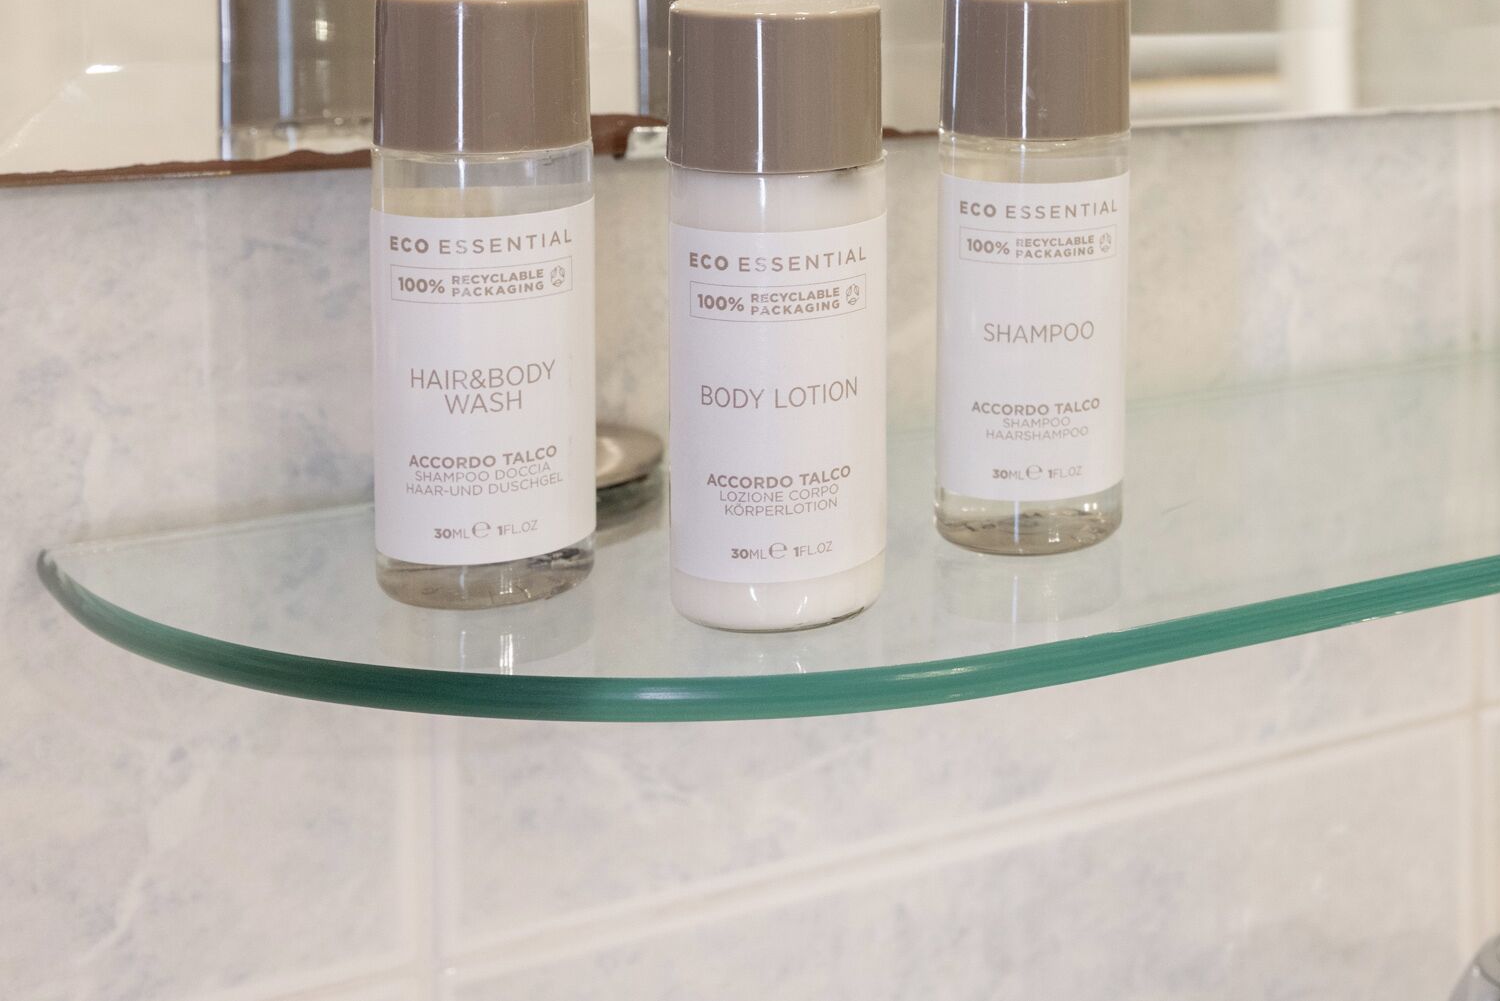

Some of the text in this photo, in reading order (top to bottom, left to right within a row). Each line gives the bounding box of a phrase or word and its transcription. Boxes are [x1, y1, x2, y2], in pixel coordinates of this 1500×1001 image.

[960, 200, 1118, 220] ECO ESSENTIAL
[390, 229, 572, 254] ECO ESSENTIAL
[967, 235, 1094, 255] 100% RECYCLABLE
[689, 247, 866, 272] ECO ESSENTIAL
[1016, 246, 1094, 259] PACKAGING
[398, 269, 544, 294] 100% RECYCLABLE
[452, 281, 544, 297] PACKAGING
[697, 287, 840, 312] 100% RECYCLABLE
[751, 300, 840, 316] PACKAGING
[984, 320, 1094, 344] SHAMPOO
[410, 360, 556, 390] HAIR&BODY
[444, 390, 522, 414] WASH
[701, 376, 858, 409] BODY LOTION
[971, 398, 1100, 416] ACCORDO TALCO
[1003, 416, 1071, 428] SHAMPOO
[986, 426, 1088, 441] HAARSHAMPOO
[409, 445, 557, 469] ACCORDO TALCO
[415, 461, 550, 483] SHAMPOO DOCCIA
[707, 465, 850, 489] ACCORDO TALCO
[992, 469, 1024, 480] 30ML
[406, 472, 563, 496] HAAR-UND DUSCHGEL
[720, 483, 838, 503] LOZIONE CORPO
[724, 497, 838, 516] KÖRPERLOTION
[434, 528, 470, 539] 30ML
[731, 548, 767, 560] 30ML
